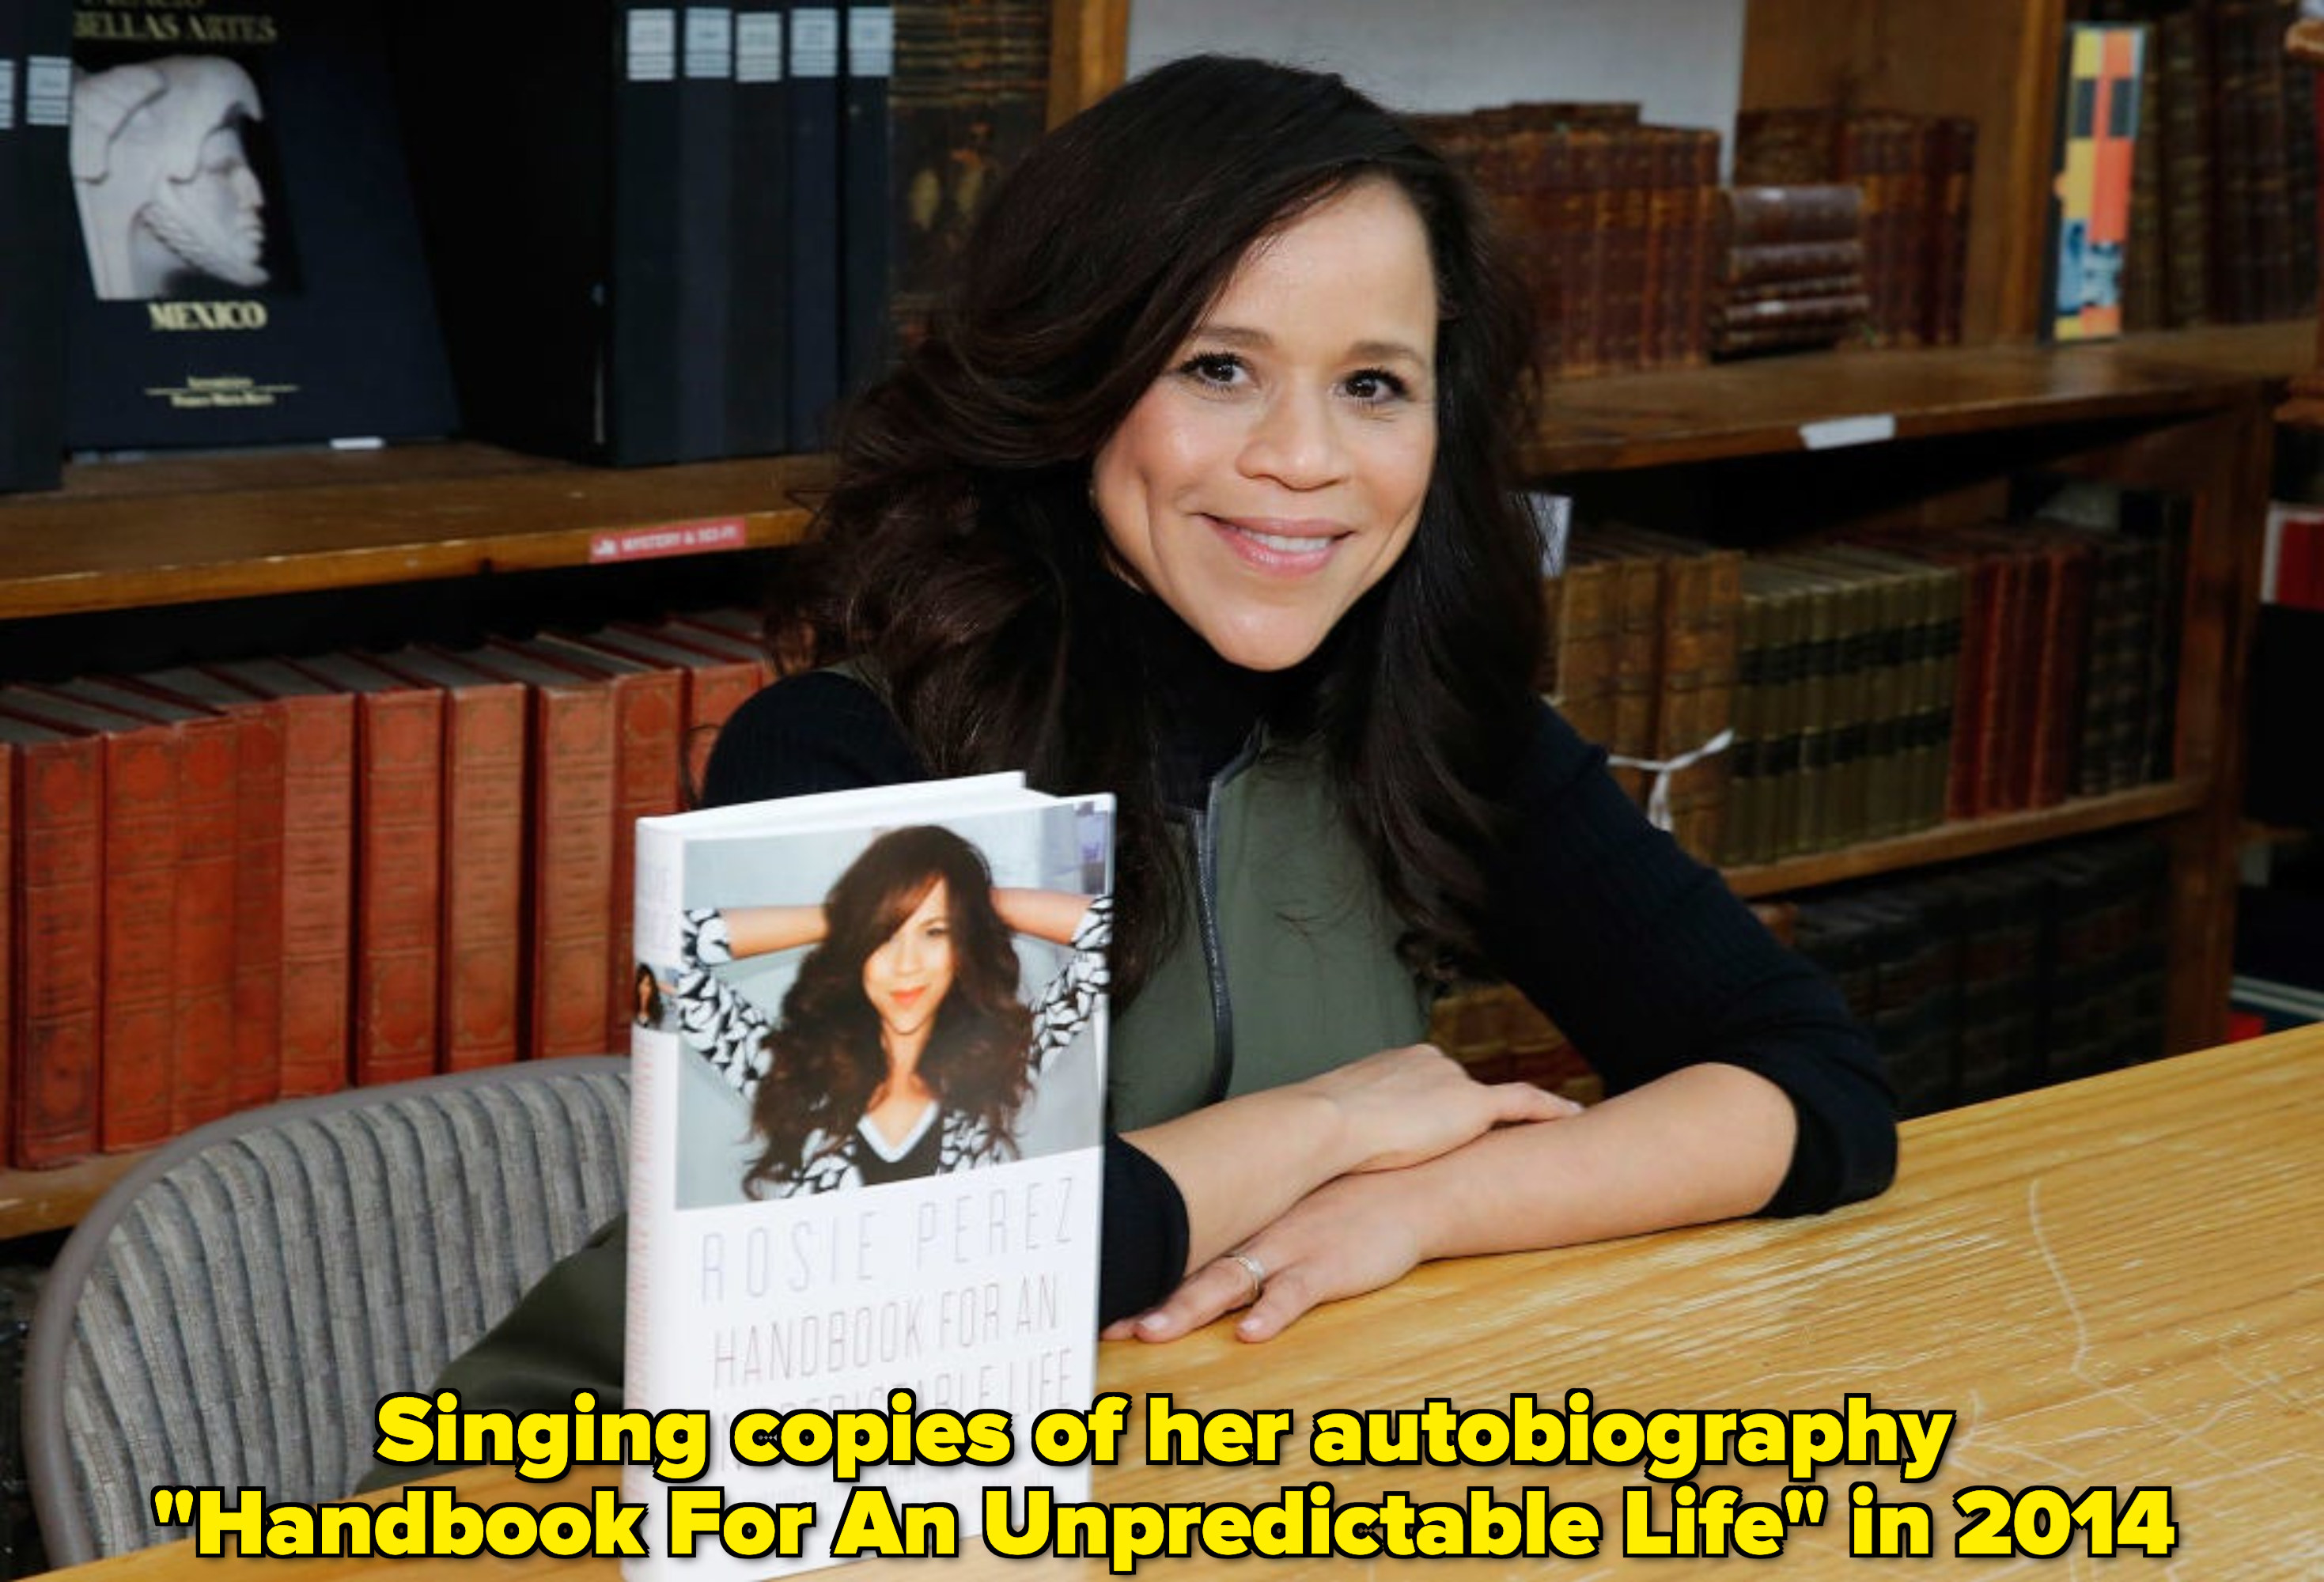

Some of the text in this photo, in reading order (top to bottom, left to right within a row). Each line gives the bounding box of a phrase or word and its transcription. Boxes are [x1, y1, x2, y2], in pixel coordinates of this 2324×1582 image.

[185, 14, 277, 43] ARTES
[148, 299, 267, 331] MEXICO
[702, 1177, 1073, 1304] ROSIE PEREZ
[713, 1273, 1058, 1390] HANDBOOK FOR AN
